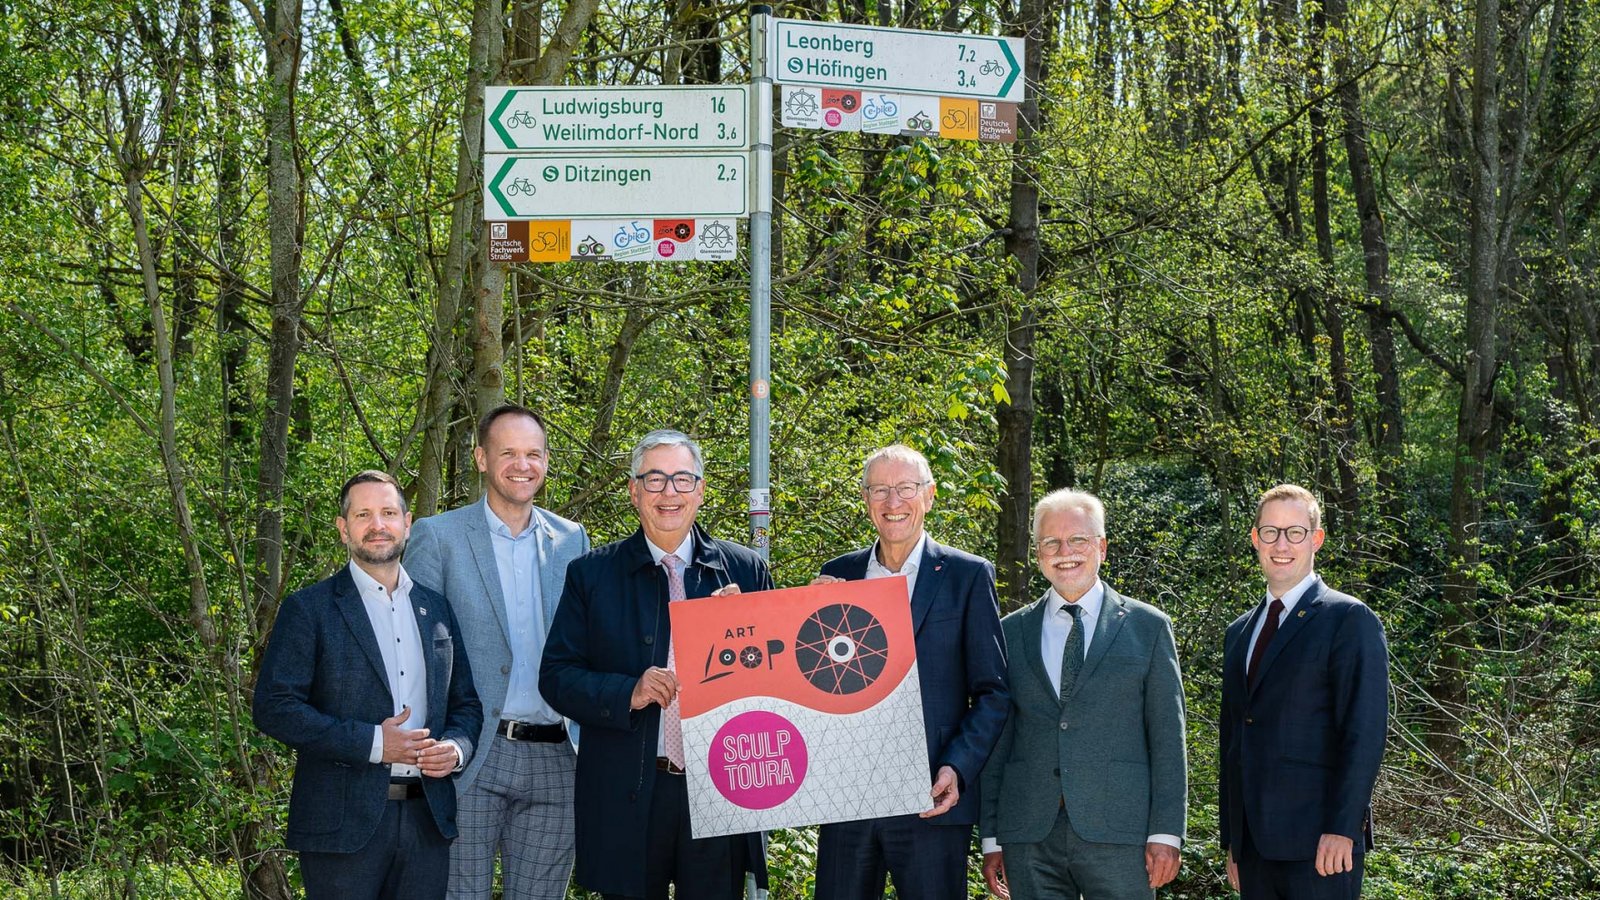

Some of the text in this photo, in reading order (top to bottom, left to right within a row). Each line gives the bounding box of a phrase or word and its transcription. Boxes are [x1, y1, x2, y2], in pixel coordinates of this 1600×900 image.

[787, 30, 976, 63] Leonberg 7,2
[807, 58, 887, 83] Höfingen
[957, 70, 976, 88] 3,4
[542, 96, 726, 118] Ludwigsburg 16
[542, 123, 737, 141] Weilimdorf-Nord 3,6
[980, 119, 1009, 127] Deutsche
[980, 126, 1012, 134] Fachwerk
[980, 132, 1000, 140] Straße
[565, 165, 651, 185] Ditzingen
[717, 164, 737, 182] 2,2
[724, 625, 756, 639] ART
[699, 639, 785, 684] LOOP
[723, 729, 791, 763] SCULP
[723, 758, 795, 791] TOURA
